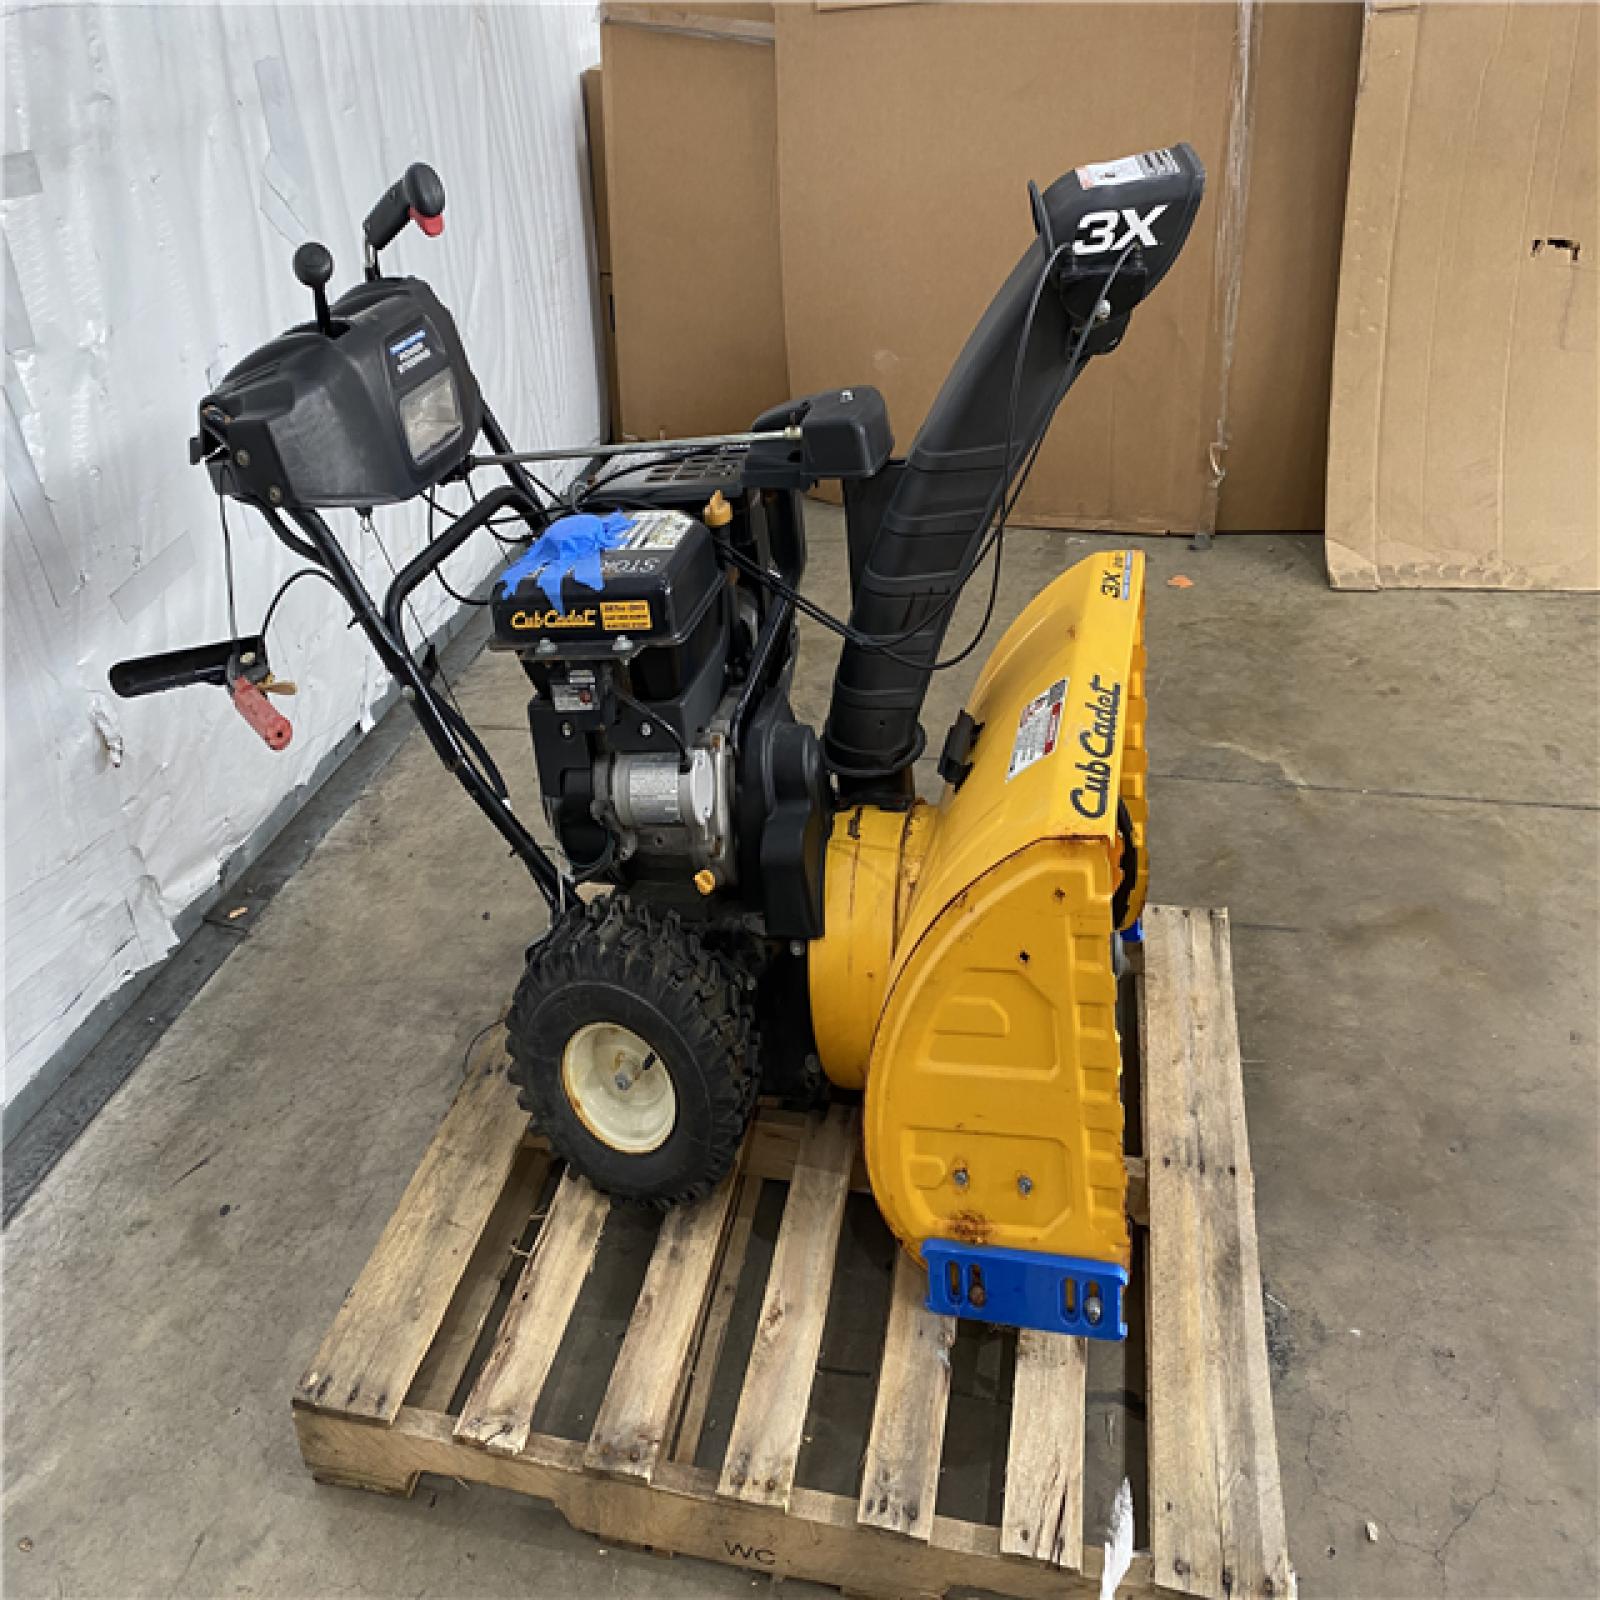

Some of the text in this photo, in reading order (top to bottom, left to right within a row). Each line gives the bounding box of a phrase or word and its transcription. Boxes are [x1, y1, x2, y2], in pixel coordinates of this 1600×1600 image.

[1072, 204, 1168, 255] 3X
[1101, 570, 1121, 599] 3X
[511, 609, 597, 630] Cub Cadet
[1069, 675, 1121, 820] Cub Cadet
[724, 1540, 776, 1566] WC
